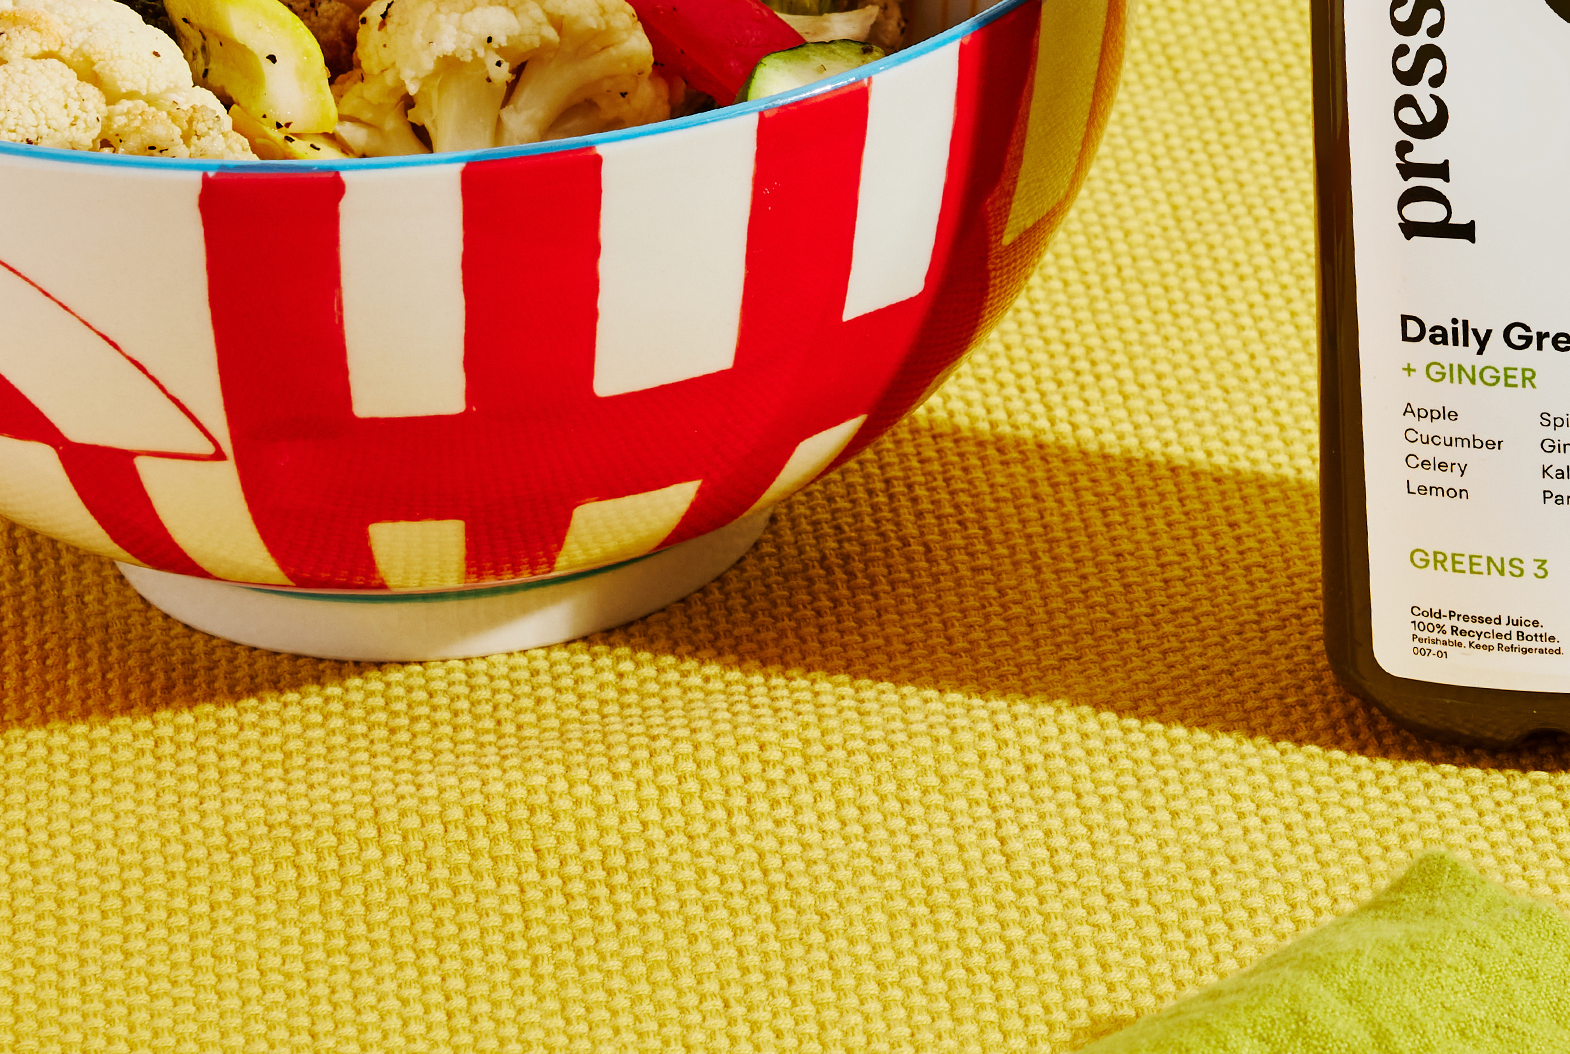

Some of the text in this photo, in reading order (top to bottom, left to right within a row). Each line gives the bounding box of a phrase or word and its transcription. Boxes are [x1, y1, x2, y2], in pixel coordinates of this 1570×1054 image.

[1400, 314, 1493, 356] Daily
[1401, 361, 1537, 389] + GINGER
[1402, 402, 1459, 423] Apple
[1403, 427, 1504, 451] Cucumber
[1404, 453, 1468, 477] Celery
[1406, 479, 1469, 500] Lemon
[1409, 547, 1549, 580] GREENS 3
[1410, 605, 1544, 628] Cold-Pressed Juice.
[1411, 620, 1561, 644] 100% Recycled Bottle.
[1411, 633, 1564, 657] Perishable. Keep Refrigerated.
[1412, 646, 1449, 659] 007-01
